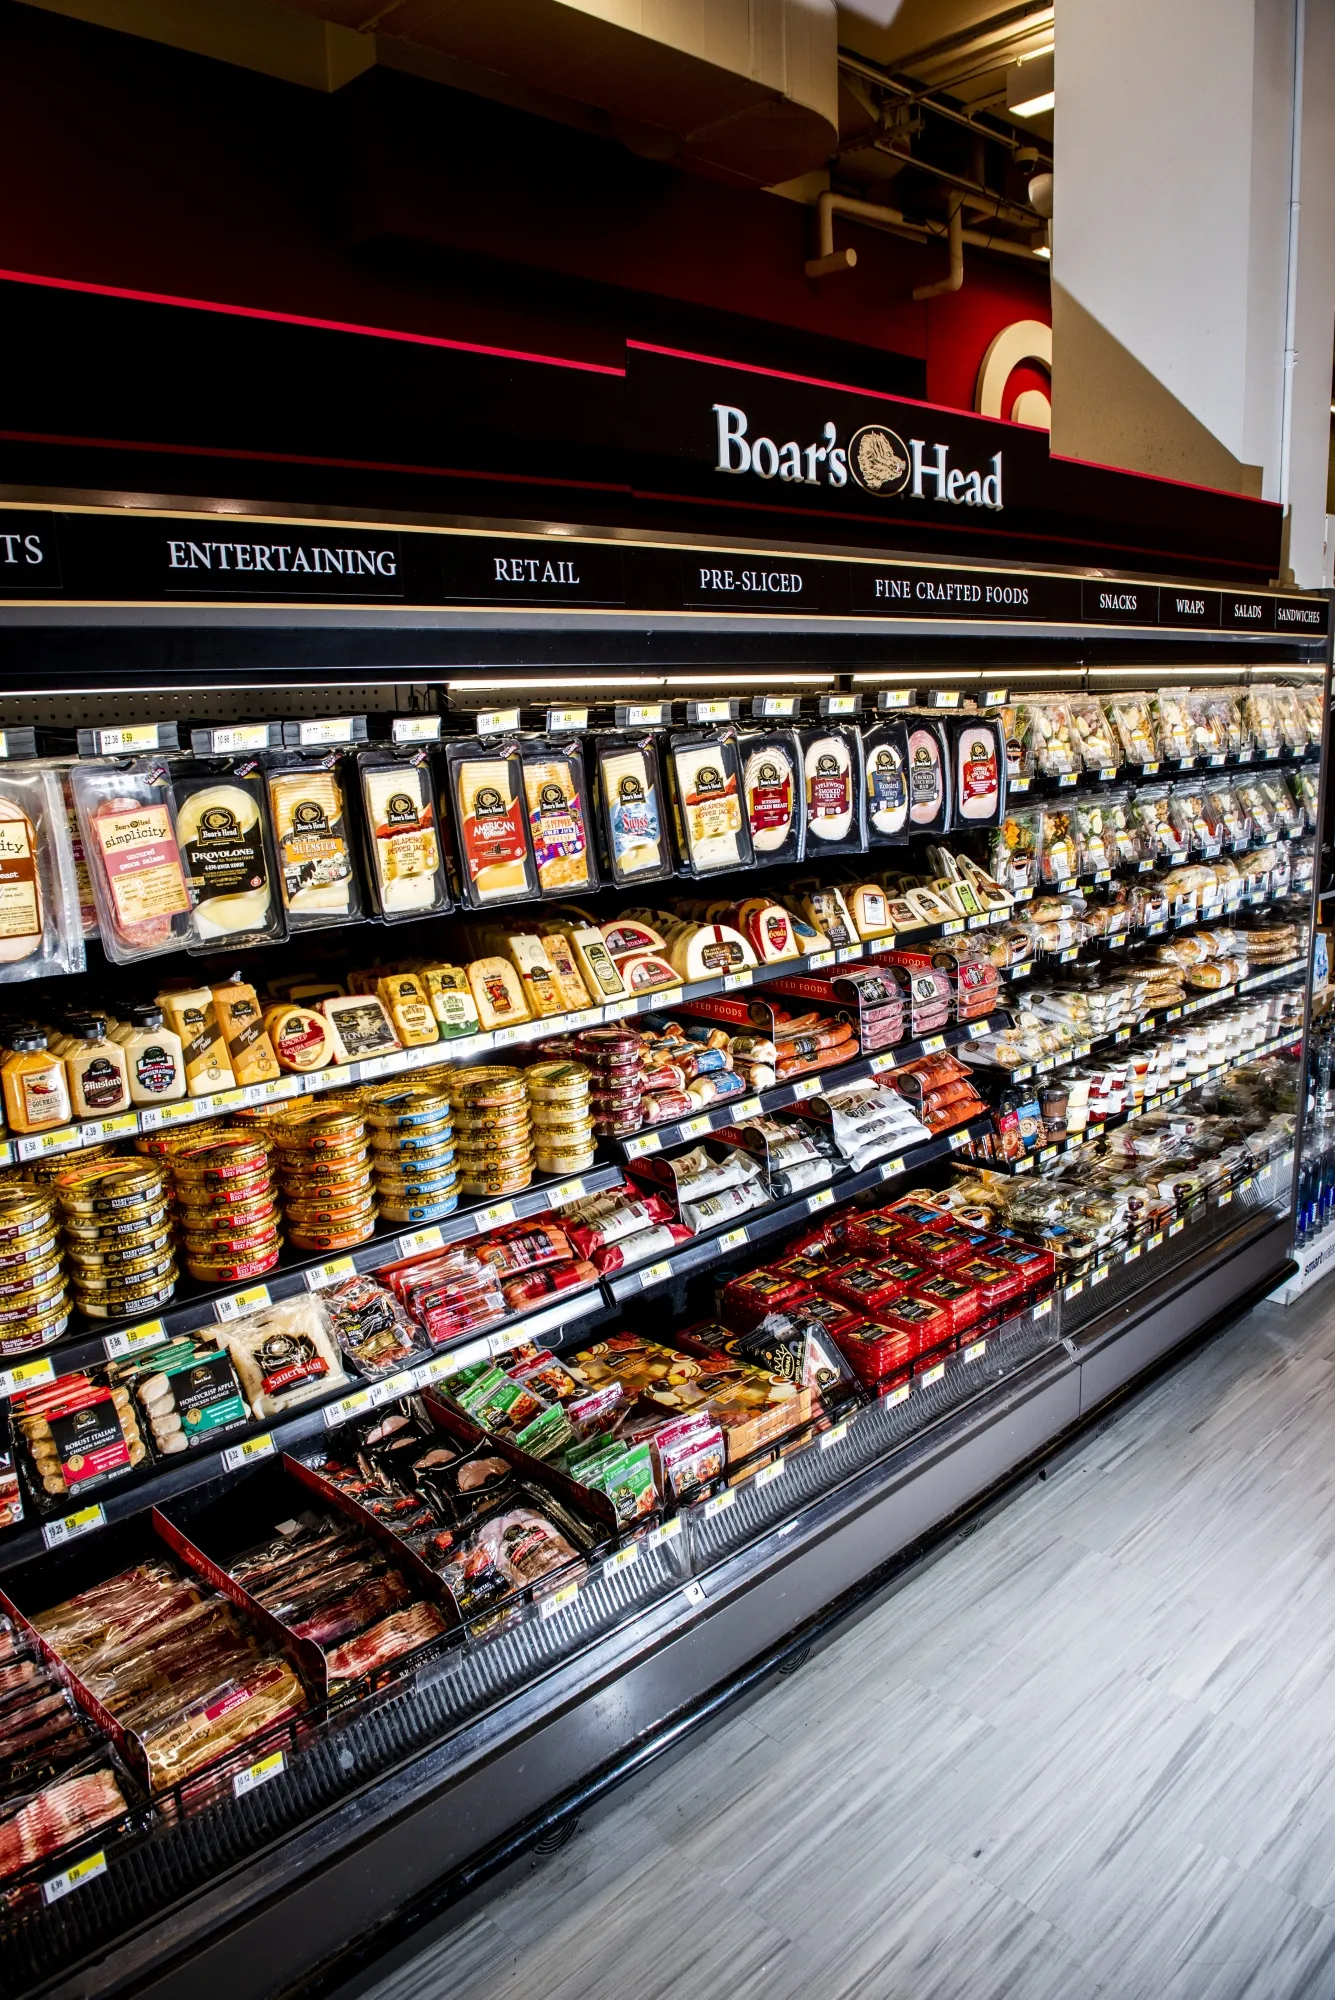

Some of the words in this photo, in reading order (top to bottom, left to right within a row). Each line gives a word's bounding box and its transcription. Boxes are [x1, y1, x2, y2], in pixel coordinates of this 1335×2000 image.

[712, 403, 848, 488] Boar's
[909, 439, 1004, 512] Head
[167, 541, 397, 576] ENTERTAINING
[493, 557, 580, 584] RETAIL
[700, 568, 803, 593] PRE-SLICED
[875, 579, 911, 598] FINE
[916, 582, 981, 602] CRAFTED
[986, 586, 1029, 605] FOODS
[1100, 593, 1138, 610] SNACKS
[1176, 599, 1205, 615] WRAPS
[1234, 604, 1262, 619] SALADS
[1277, 607, 1320, 624] SANDWICHES
[104, 735, 119, 745] 22.36
[121, 733, 133, 743] 5.59
[815, 781, 845, 791] APPLEWOOD
[879, 782, 899, 790] Roasted
[880, 789, 899, 798] Turkey
[695, 810, 717, 819] PEPPER
[296, 823, 313, 831] Boar's
[473, 821, 516, 837] AMERICAN
[550, 818, 572, 828] PEPPER
[622, 813, 648, 832] Swiss
[104, 827, 167, 849] simplicity
[202, 830, 222, 839] Boar's
[222, 828, 238, 836] Head
[125, 848, 156, 861] uncured
[292, 842, 337, 854] MUENSTER
[388, 845, 412, 856] PEPPER
[413, 844, 428, 852] JACK
[191, 848, 254, 863] PROVOLONE
[768, 929, 787, 939] Gouda
[626, 939, 644, 948] EDAM
[897, 957, 926, 967] FOODS
[651, 974, 667, 983] EDAM
[799, 983, 828, 994] FOODS
[714, 1005, 742, 1017] FOODS
[281, 1034, 308, 1048] SMOKED
[139, 1069, 174, 1080] HORSERADISH
[83, 1076, 122, 1092] Mustard
[144, 1115, 156, 1125] 5.14
[85, 1127, 97, 1137] 4.39
[24, 1142, 37, 1153] 6.58
[235, 1165, 254, 1175] PEPPER
[230, 1194, 243, 1202] RED
[243, 1188, 260, 1198] PEPPER
[235, 1218, 246, 1226] RED
[246, 1212, 264, 1223] PEPPER
[233, 1242, 245, 1250] RED
[246, 1237, 264, 1248] PEPPER
[249, 1262, 267, 1272] PEPPER
[220, 1302, 232, 1313] 5.86
[109, 1337, 122, 1348] 5.86
[179, 1387, 216, 1407] HONEYCRISP
[217, 1380, 234, 1392] APPLE
[188, 1398, 210, 1409] CHICKEN
[210, 1390, 230, 1400] SAUSAGE
[64, 1435, 91, 1452] ROBUST
[91, 1426, 117, 1440] ITALIAN
[69, 1444, 93, 1456] CHICKEN
[93, 1435, 115, 1448] SAUSAGE
[48, 1523, 64, 1539] 19.25
[65, 1518, 76, 1530] 5.39
[207, 1566, 224, 1588] FINE
[399, 1659, 428, 1678] BROWN
[219, 1694, 250, 1715] uncured
[251, 1680, 272, 1696] bacon
[343, 1695, 357, 1706] Head
[177, 1726, 193, 1739] Head
[50, 1879, 63, 1893] 6.99
